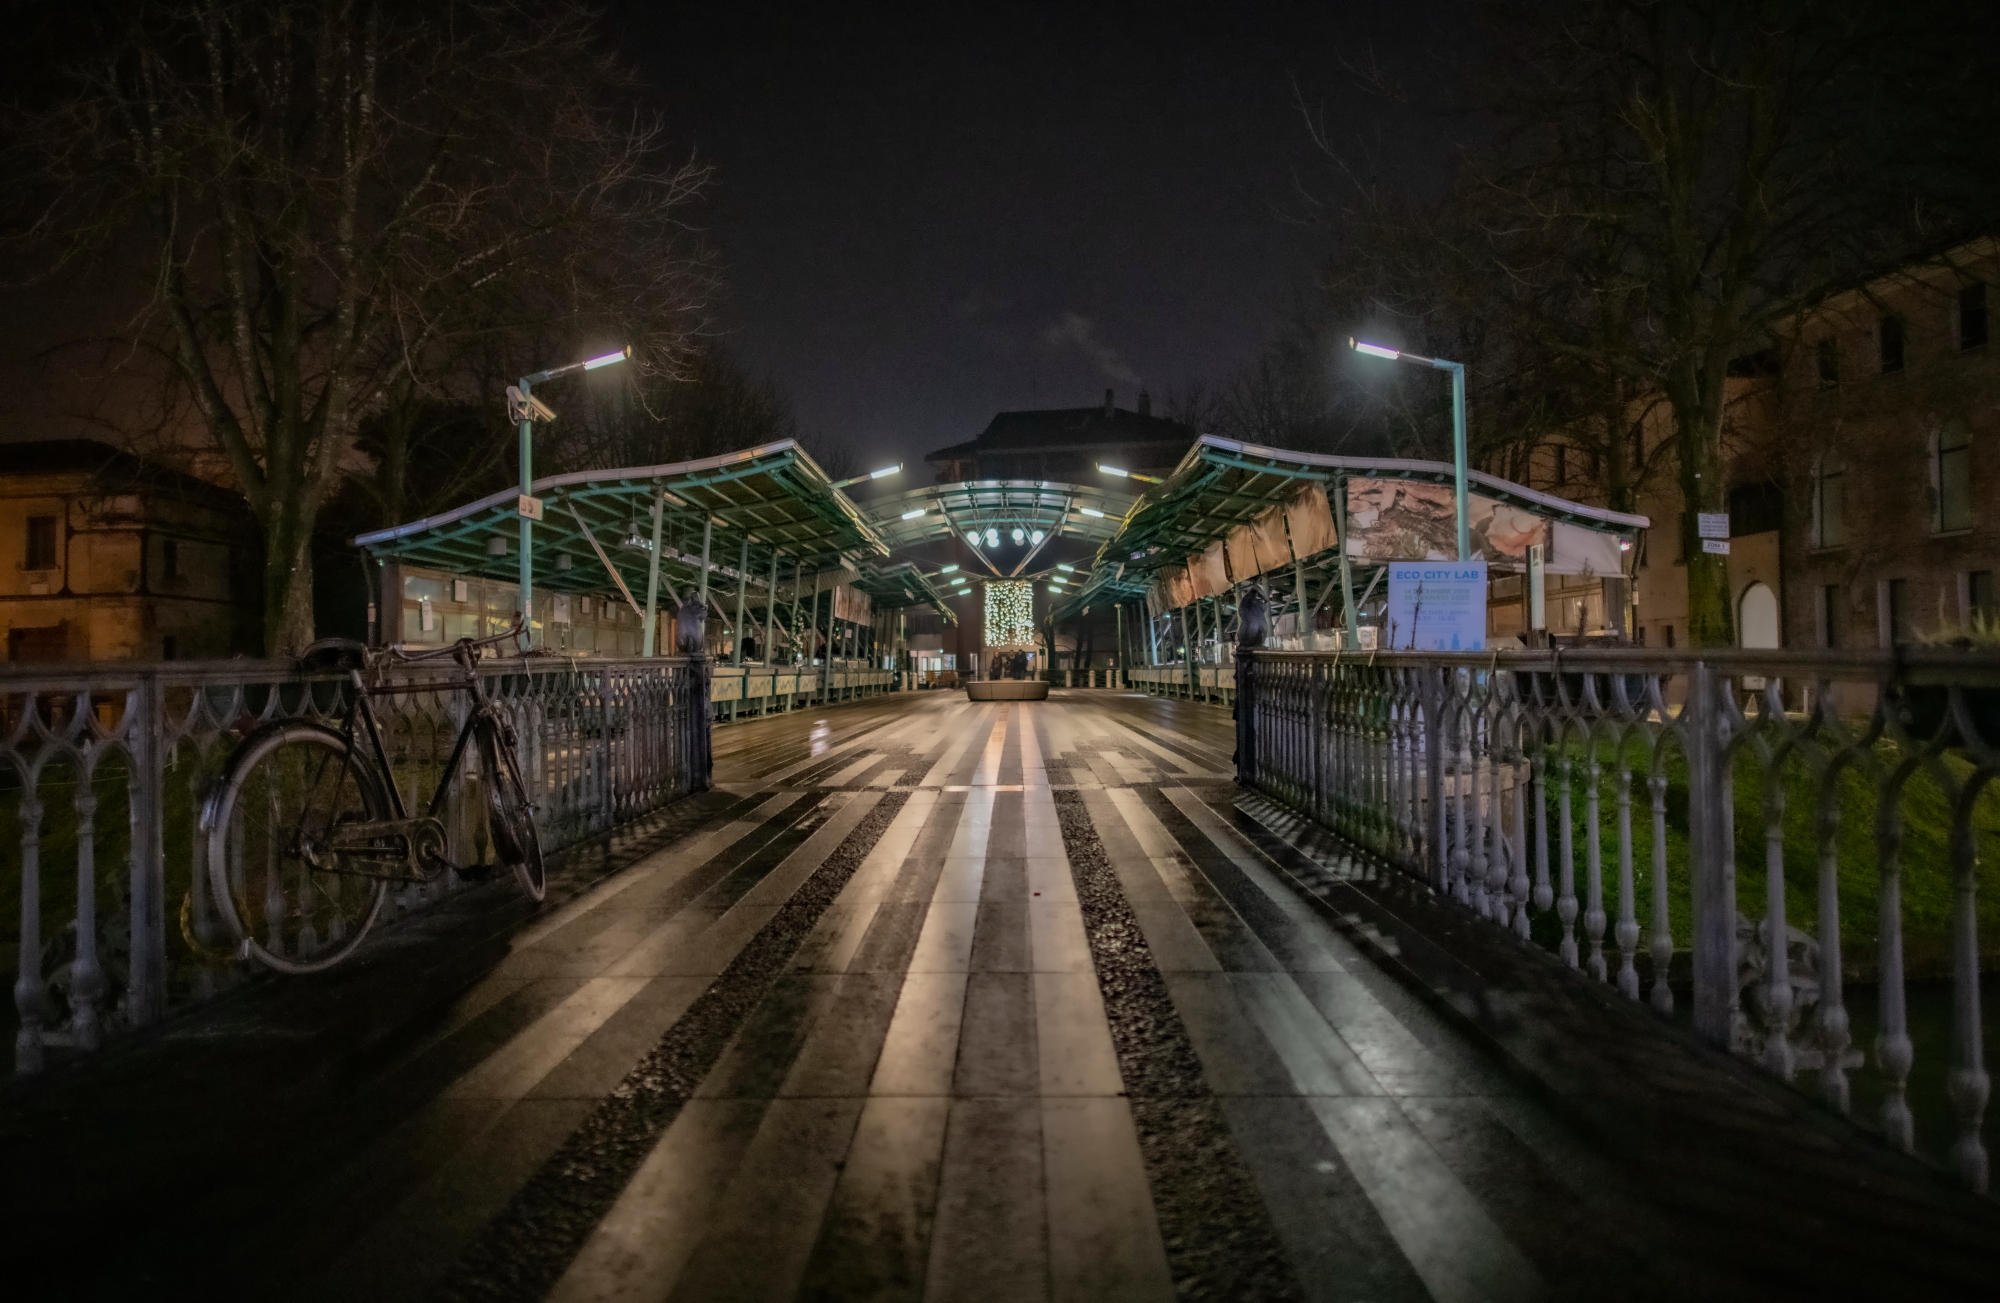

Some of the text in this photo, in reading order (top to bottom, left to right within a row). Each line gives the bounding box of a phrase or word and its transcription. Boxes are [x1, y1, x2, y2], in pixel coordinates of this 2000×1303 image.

[1396, 571, 1479, 579] ECO CITY LAB
